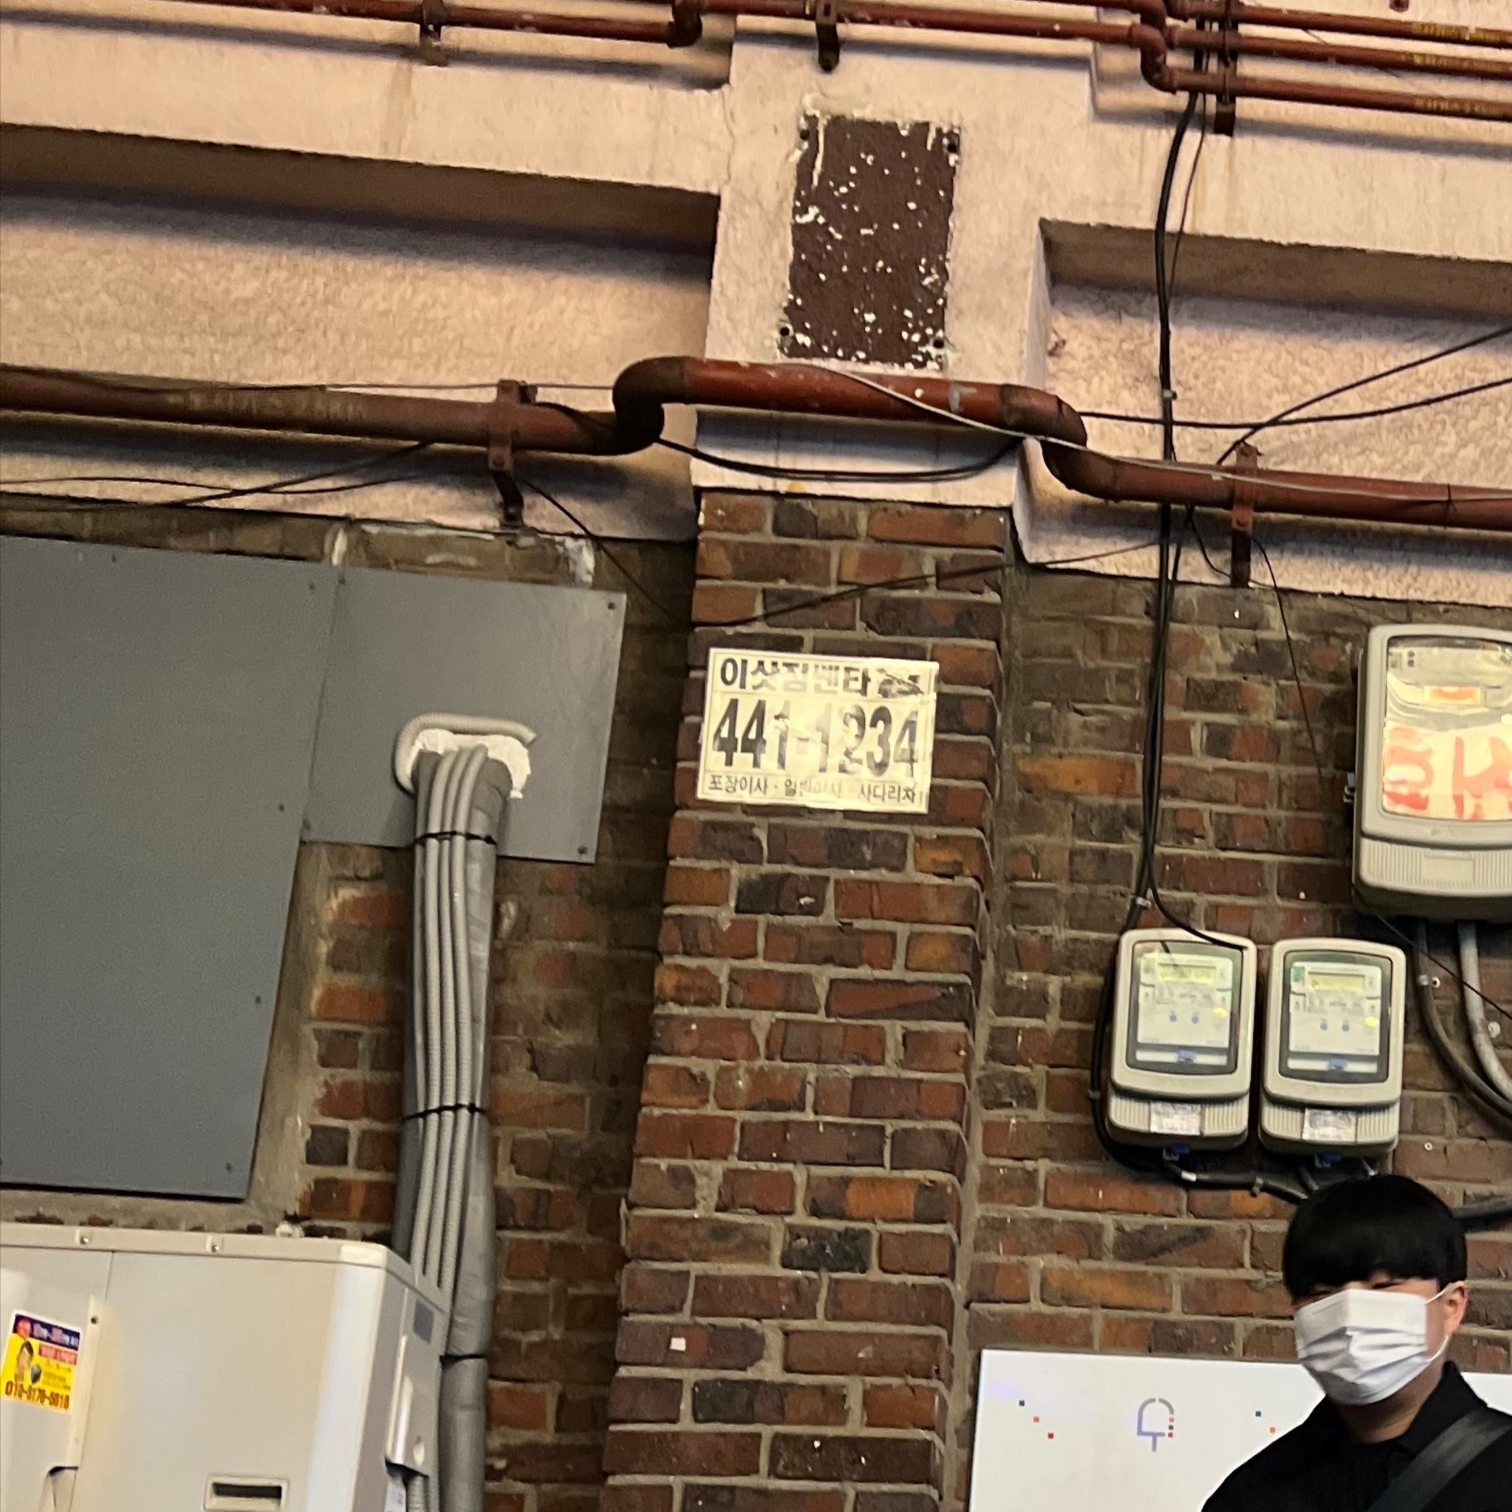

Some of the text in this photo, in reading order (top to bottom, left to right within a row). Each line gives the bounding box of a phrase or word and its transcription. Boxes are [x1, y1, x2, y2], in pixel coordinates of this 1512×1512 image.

[712, 698, 920, 777] 441-1234
[708, 774, 768, 795] 포장이사
[859, 783, 916, 803] 사다리차
